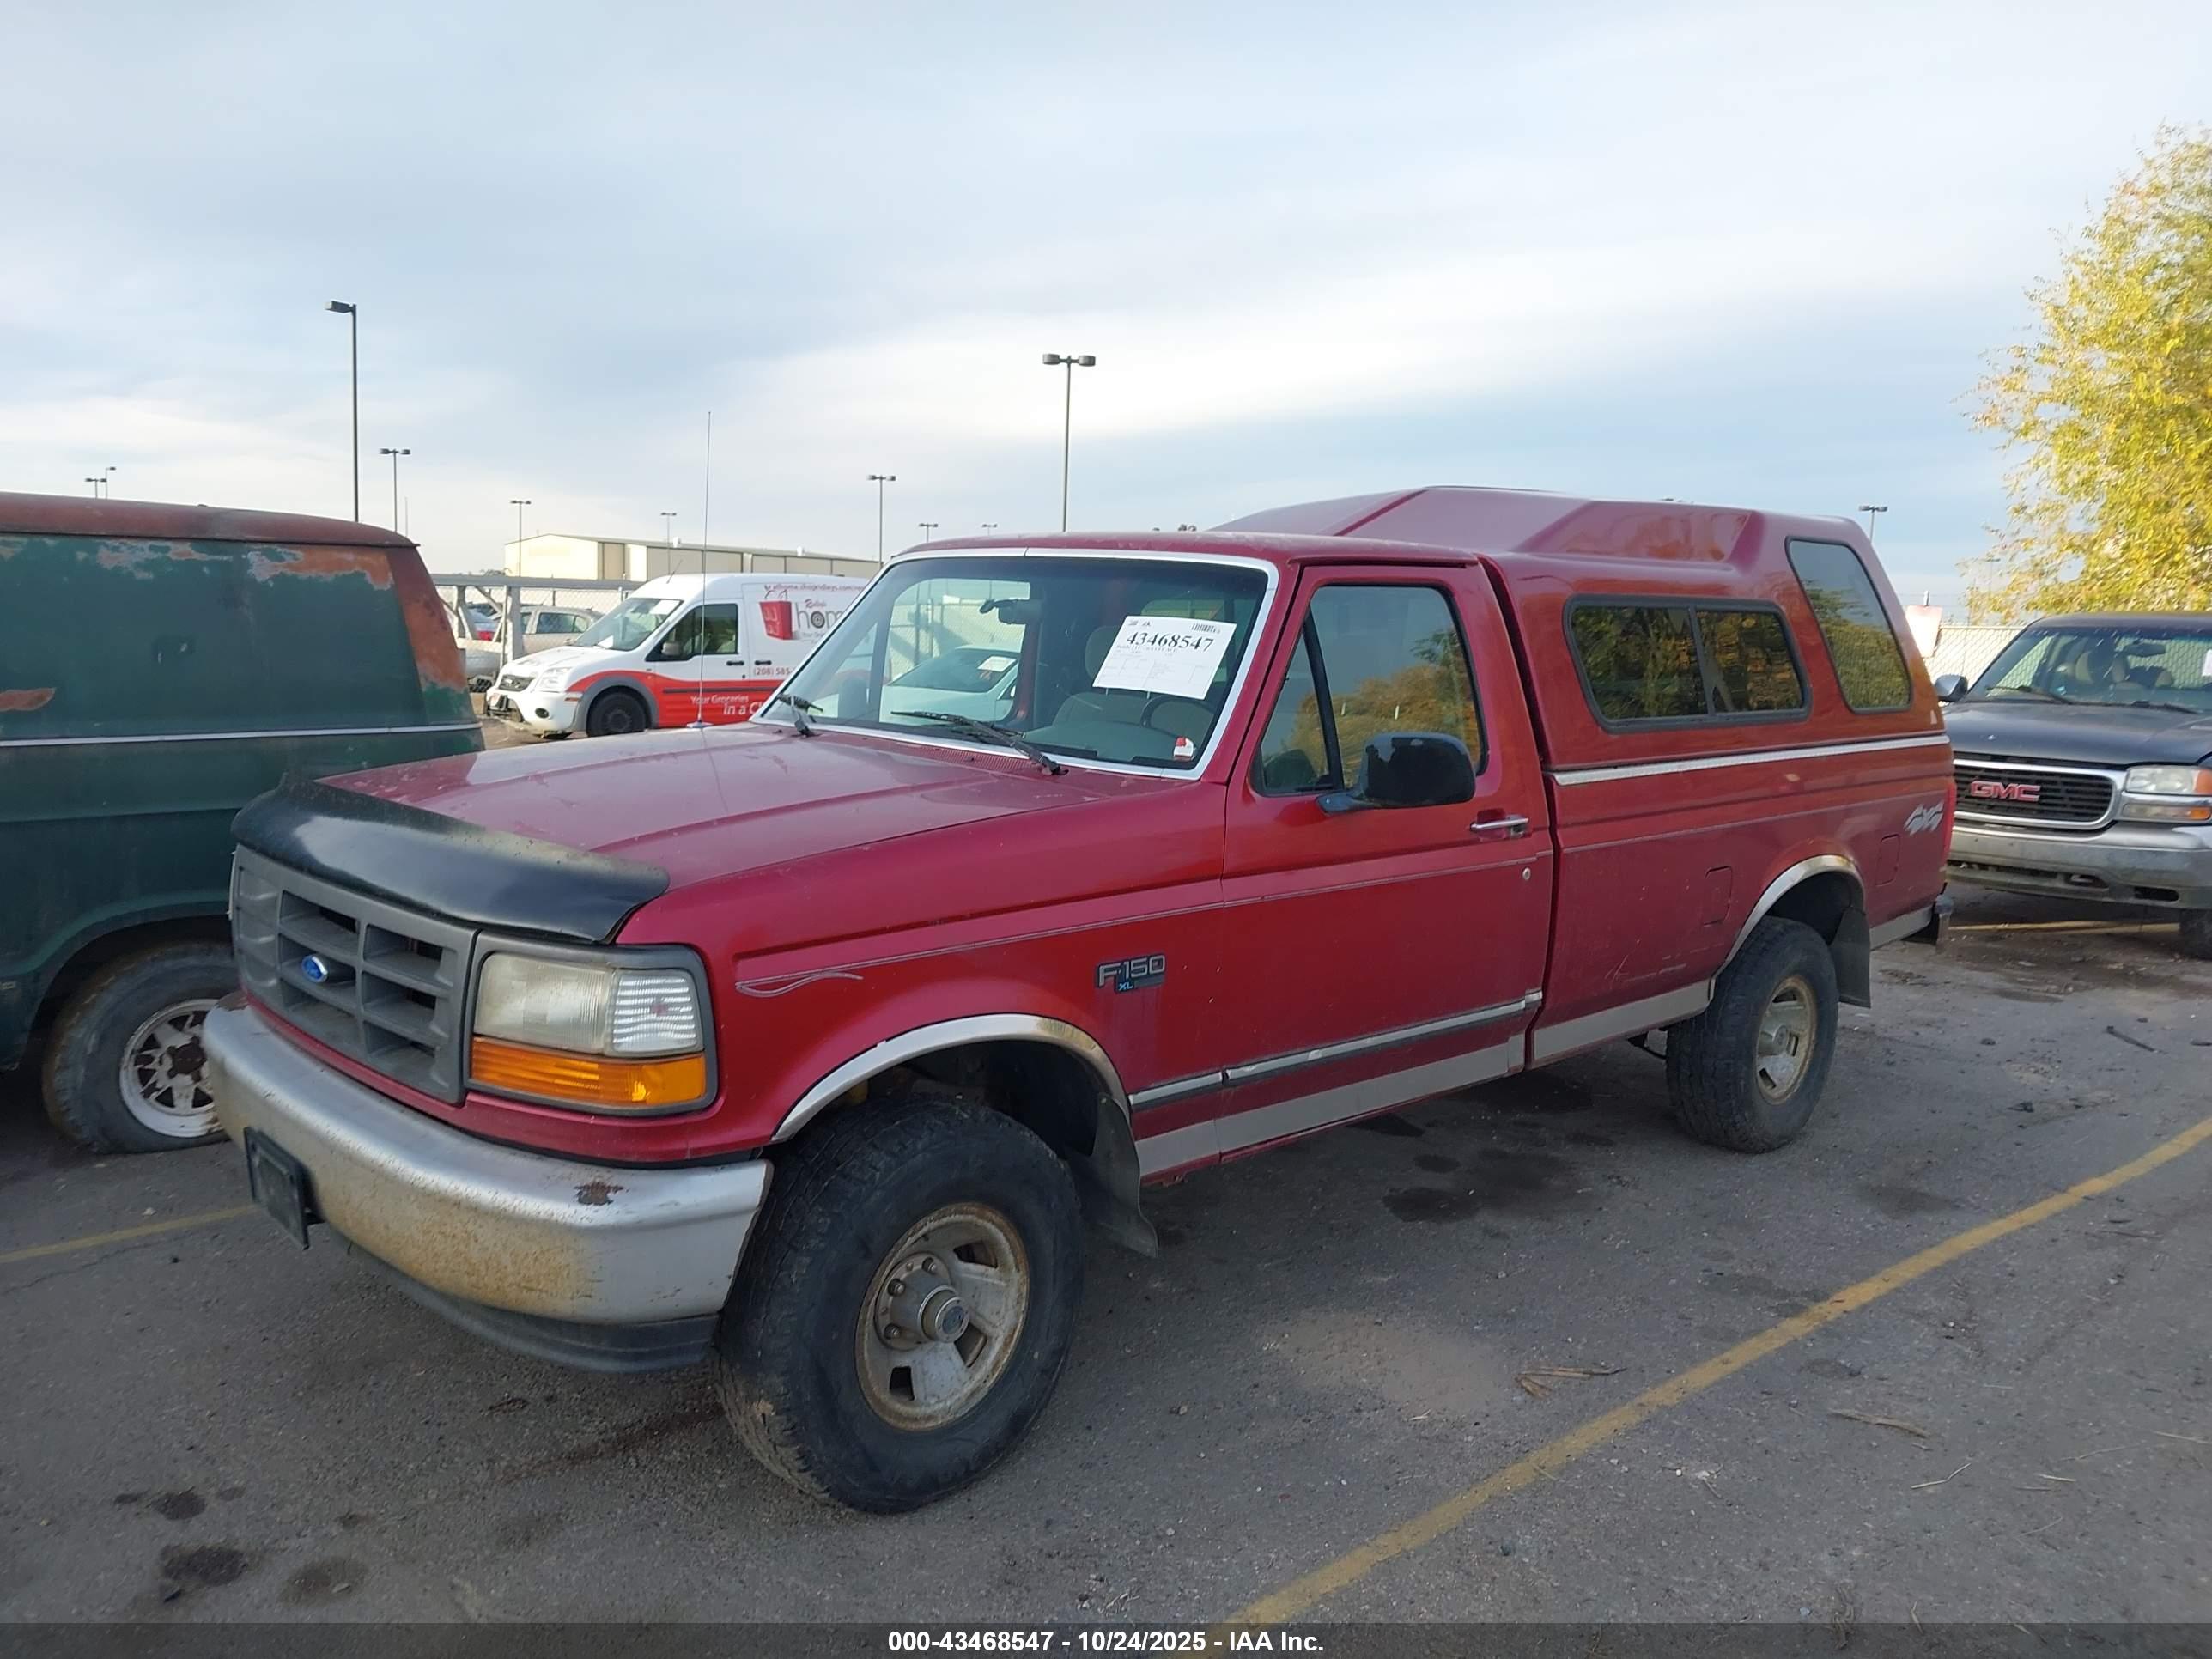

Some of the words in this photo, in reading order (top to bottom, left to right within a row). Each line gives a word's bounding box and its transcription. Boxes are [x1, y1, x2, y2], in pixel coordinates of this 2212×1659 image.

[1126, 631, 1213, 652] 43468547
[690, 696, 710, 704] Your
[711, 695, 749, 704] Groceries
[723, 703, 736, 715] in
[738, 706, 746, 715] a
[1971, 781, 2040, 802] GMC
[1118, 981, 1133, 991] XL
